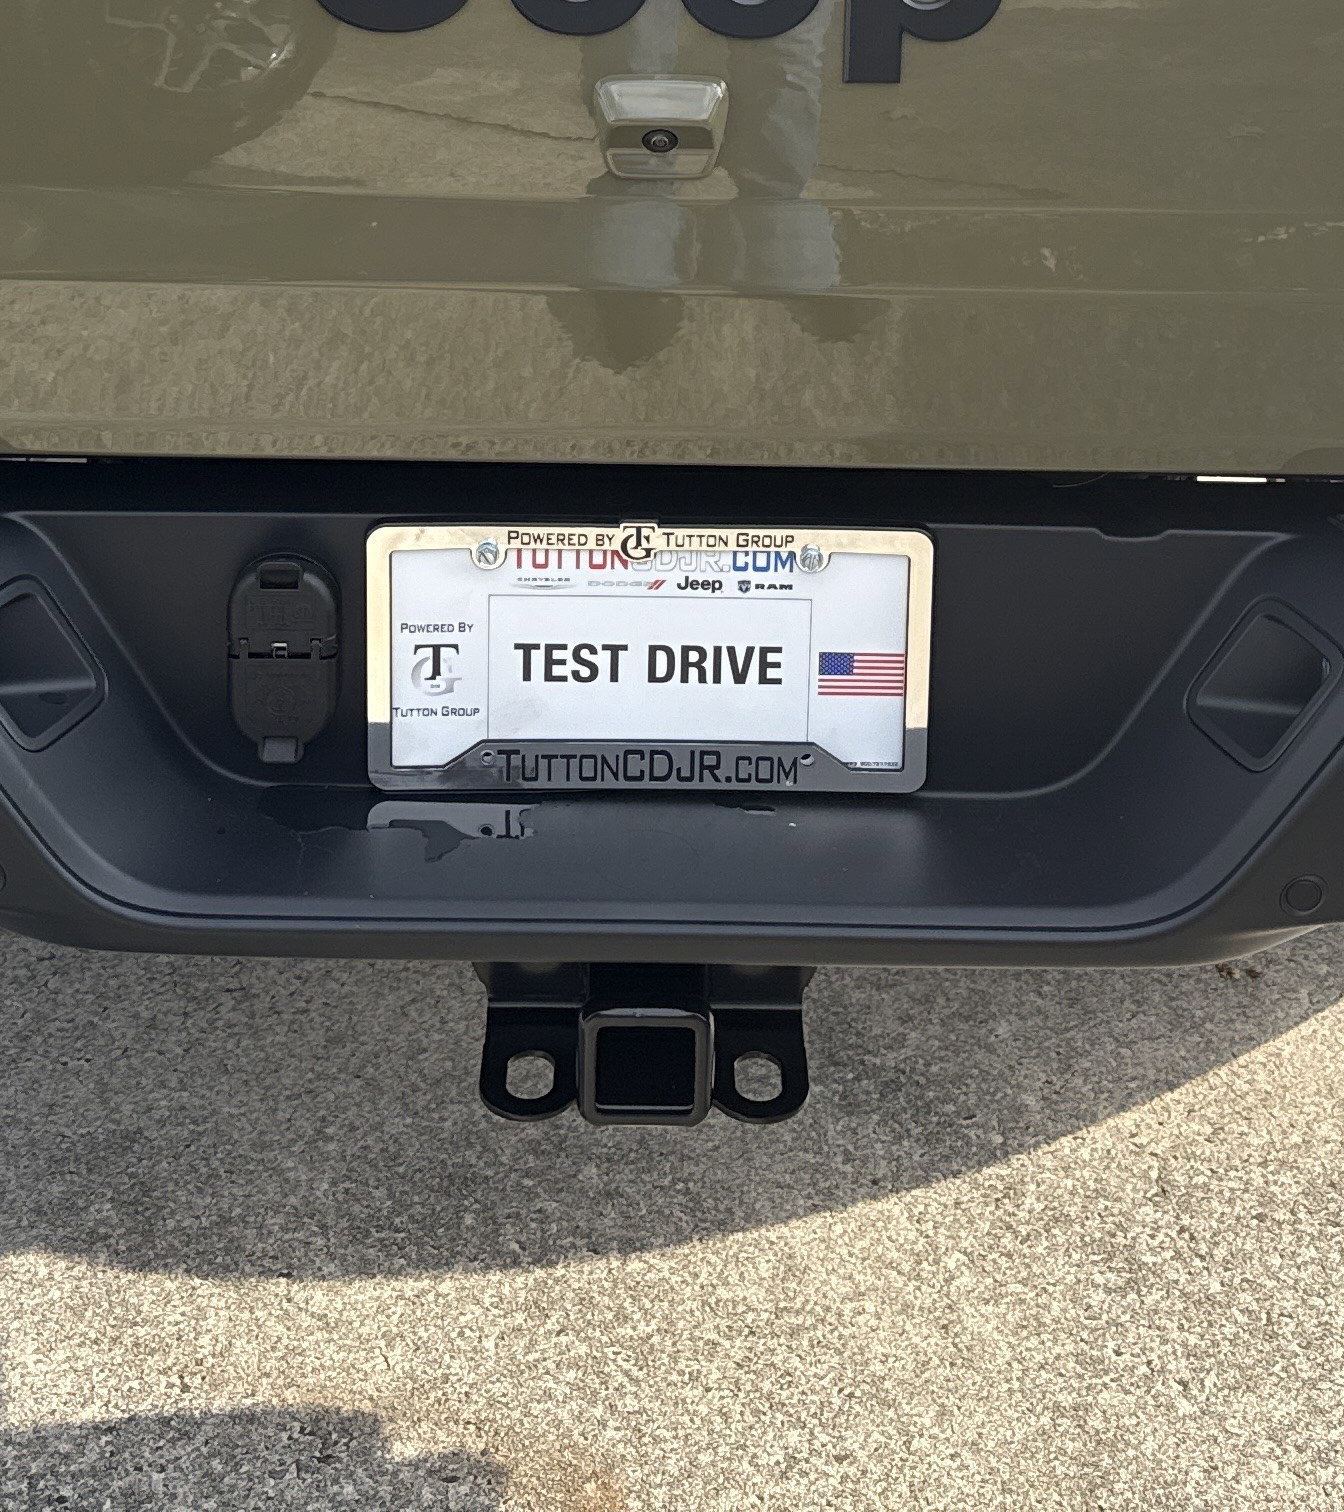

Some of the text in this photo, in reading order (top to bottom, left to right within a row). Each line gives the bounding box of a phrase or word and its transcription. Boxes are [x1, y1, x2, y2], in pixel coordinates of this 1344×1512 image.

[507, 530, 588, 546] POWERED
[595, 533, 616, 547] BY
[662, 532, 729, 548] TUTTON
[736, 533, 795, 548] GROUP
[677, 576, 723, 593] Jeep
[400, 622, 474, 633] POWERED BY
[514, 642, 783, 685] TEST DRIVE
[392, 705, 480, 718] TUTTON GROUP
[497, 749, 798, 784] TUTTONCDJR.COM
